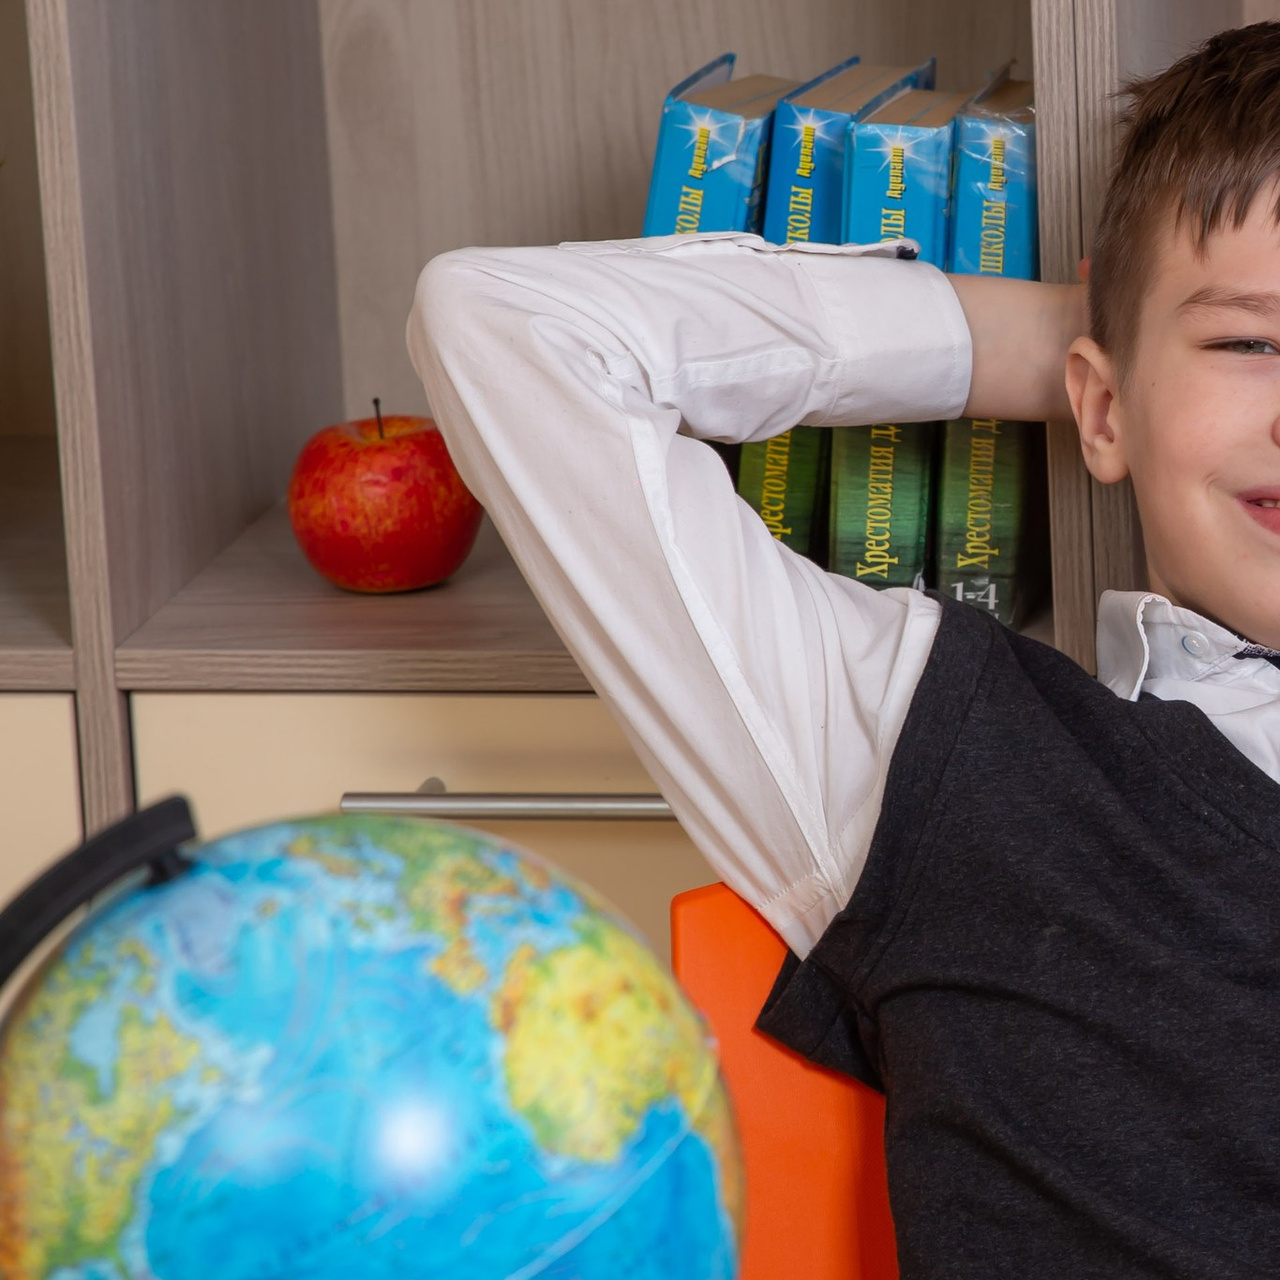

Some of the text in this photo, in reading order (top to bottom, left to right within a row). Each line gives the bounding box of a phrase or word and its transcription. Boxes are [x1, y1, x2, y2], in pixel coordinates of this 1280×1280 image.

[675, 185, 704, 234] КОЛЫ
[787, 185, 813, 244] КОЛЫ
[980, 200, 1006, 274] ШКОЛЫ
[856, 446, 899, 579] Хрестоматия
[956, 437, 999, 569] Хрестоматия
